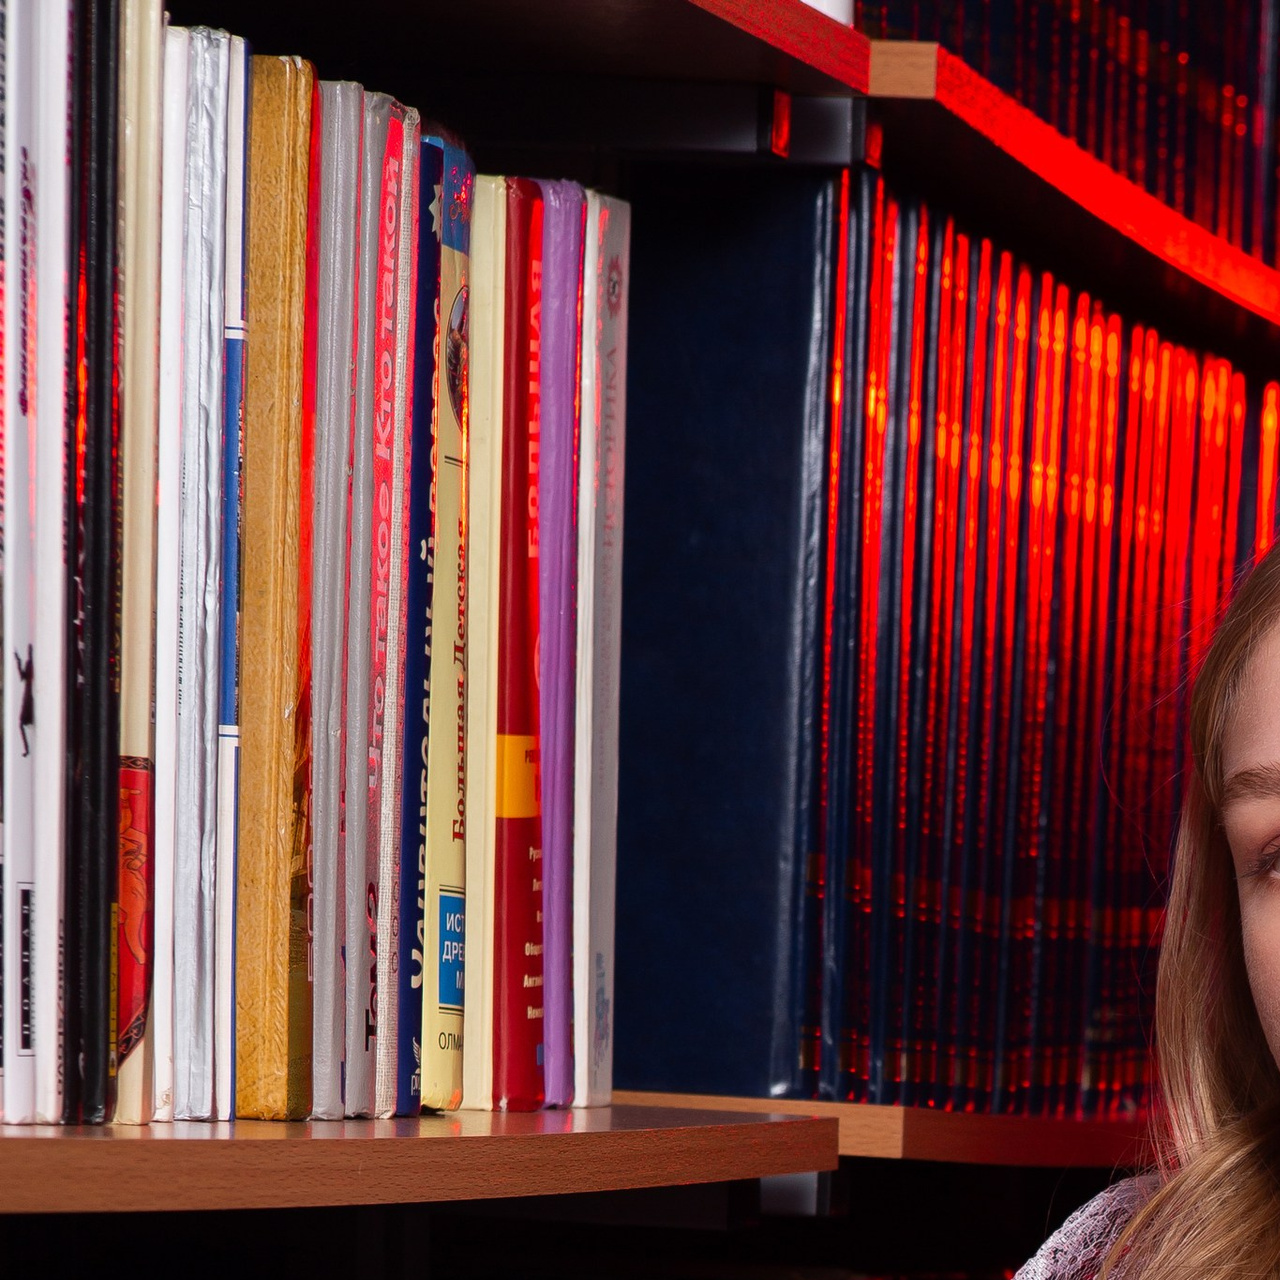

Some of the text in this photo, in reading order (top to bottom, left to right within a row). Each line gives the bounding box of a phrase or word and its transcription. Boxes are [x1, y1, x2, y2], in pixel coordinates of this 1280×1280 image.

[368, 155, 400, 788] Что такое Кто такой
[527, 259, 543, 558] БОЛЬШАЯ
[452, 516, 467, 843] Большая Детская
